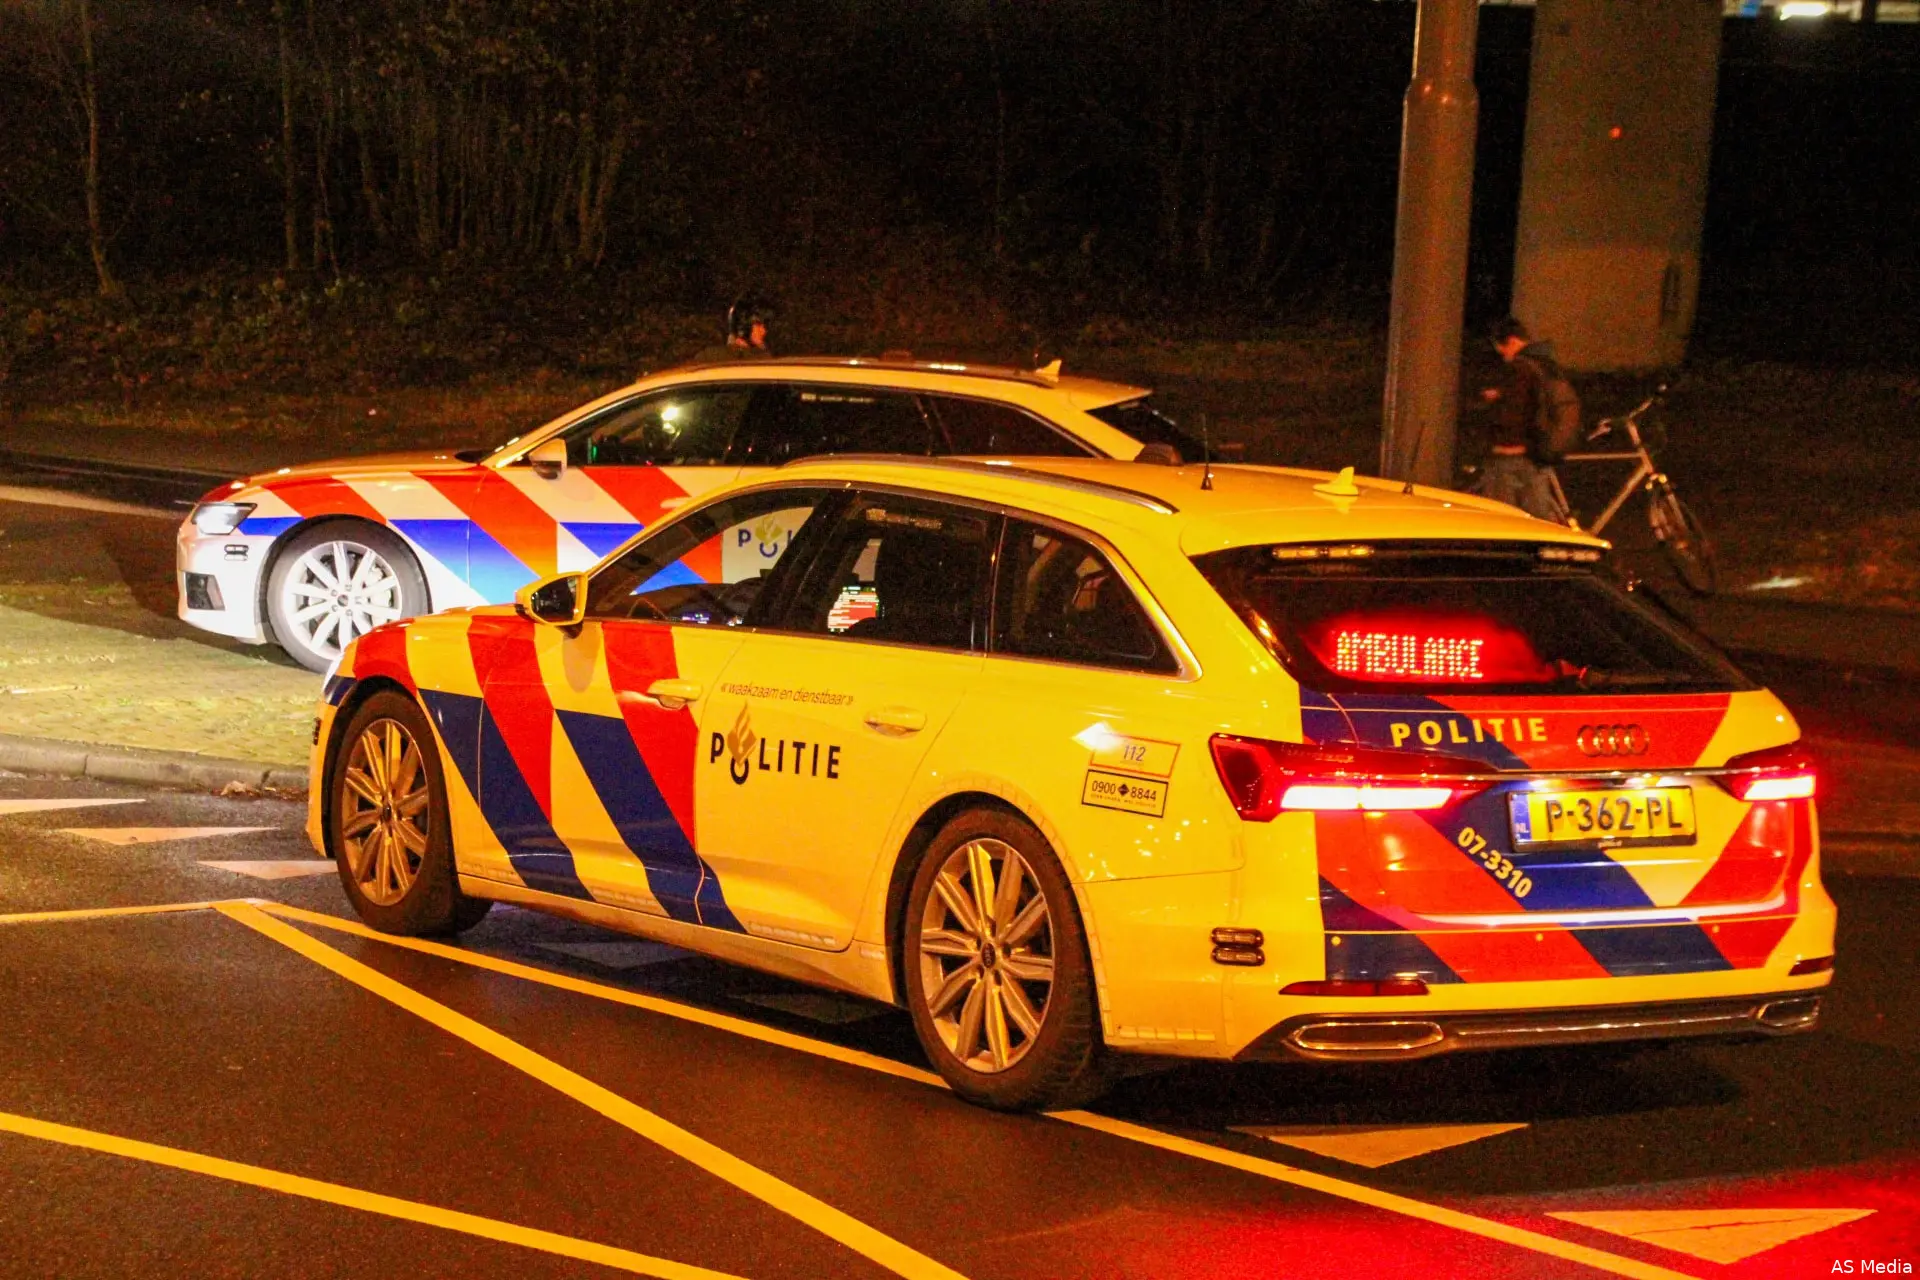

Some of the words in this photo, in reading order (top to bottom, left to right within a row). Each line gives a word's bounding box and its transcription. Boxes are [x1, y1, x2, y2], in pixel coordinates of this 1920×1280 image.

[1337, 631, 1484, 678] AMBULANCE
[780, 689, 793, 700] en
[1389, 717, 1548, 748] POLITIE
[710, 731, 841, 785] POLITIE
[1123, 744, 1146, 762] 112
[1091, 780, 1116, 795] 0900
[1130, 786, 1157, 802] 8844
[1545, 796, 1683, 833] P-362-PL
[1457, 827, 1533, 899] 07-3310
